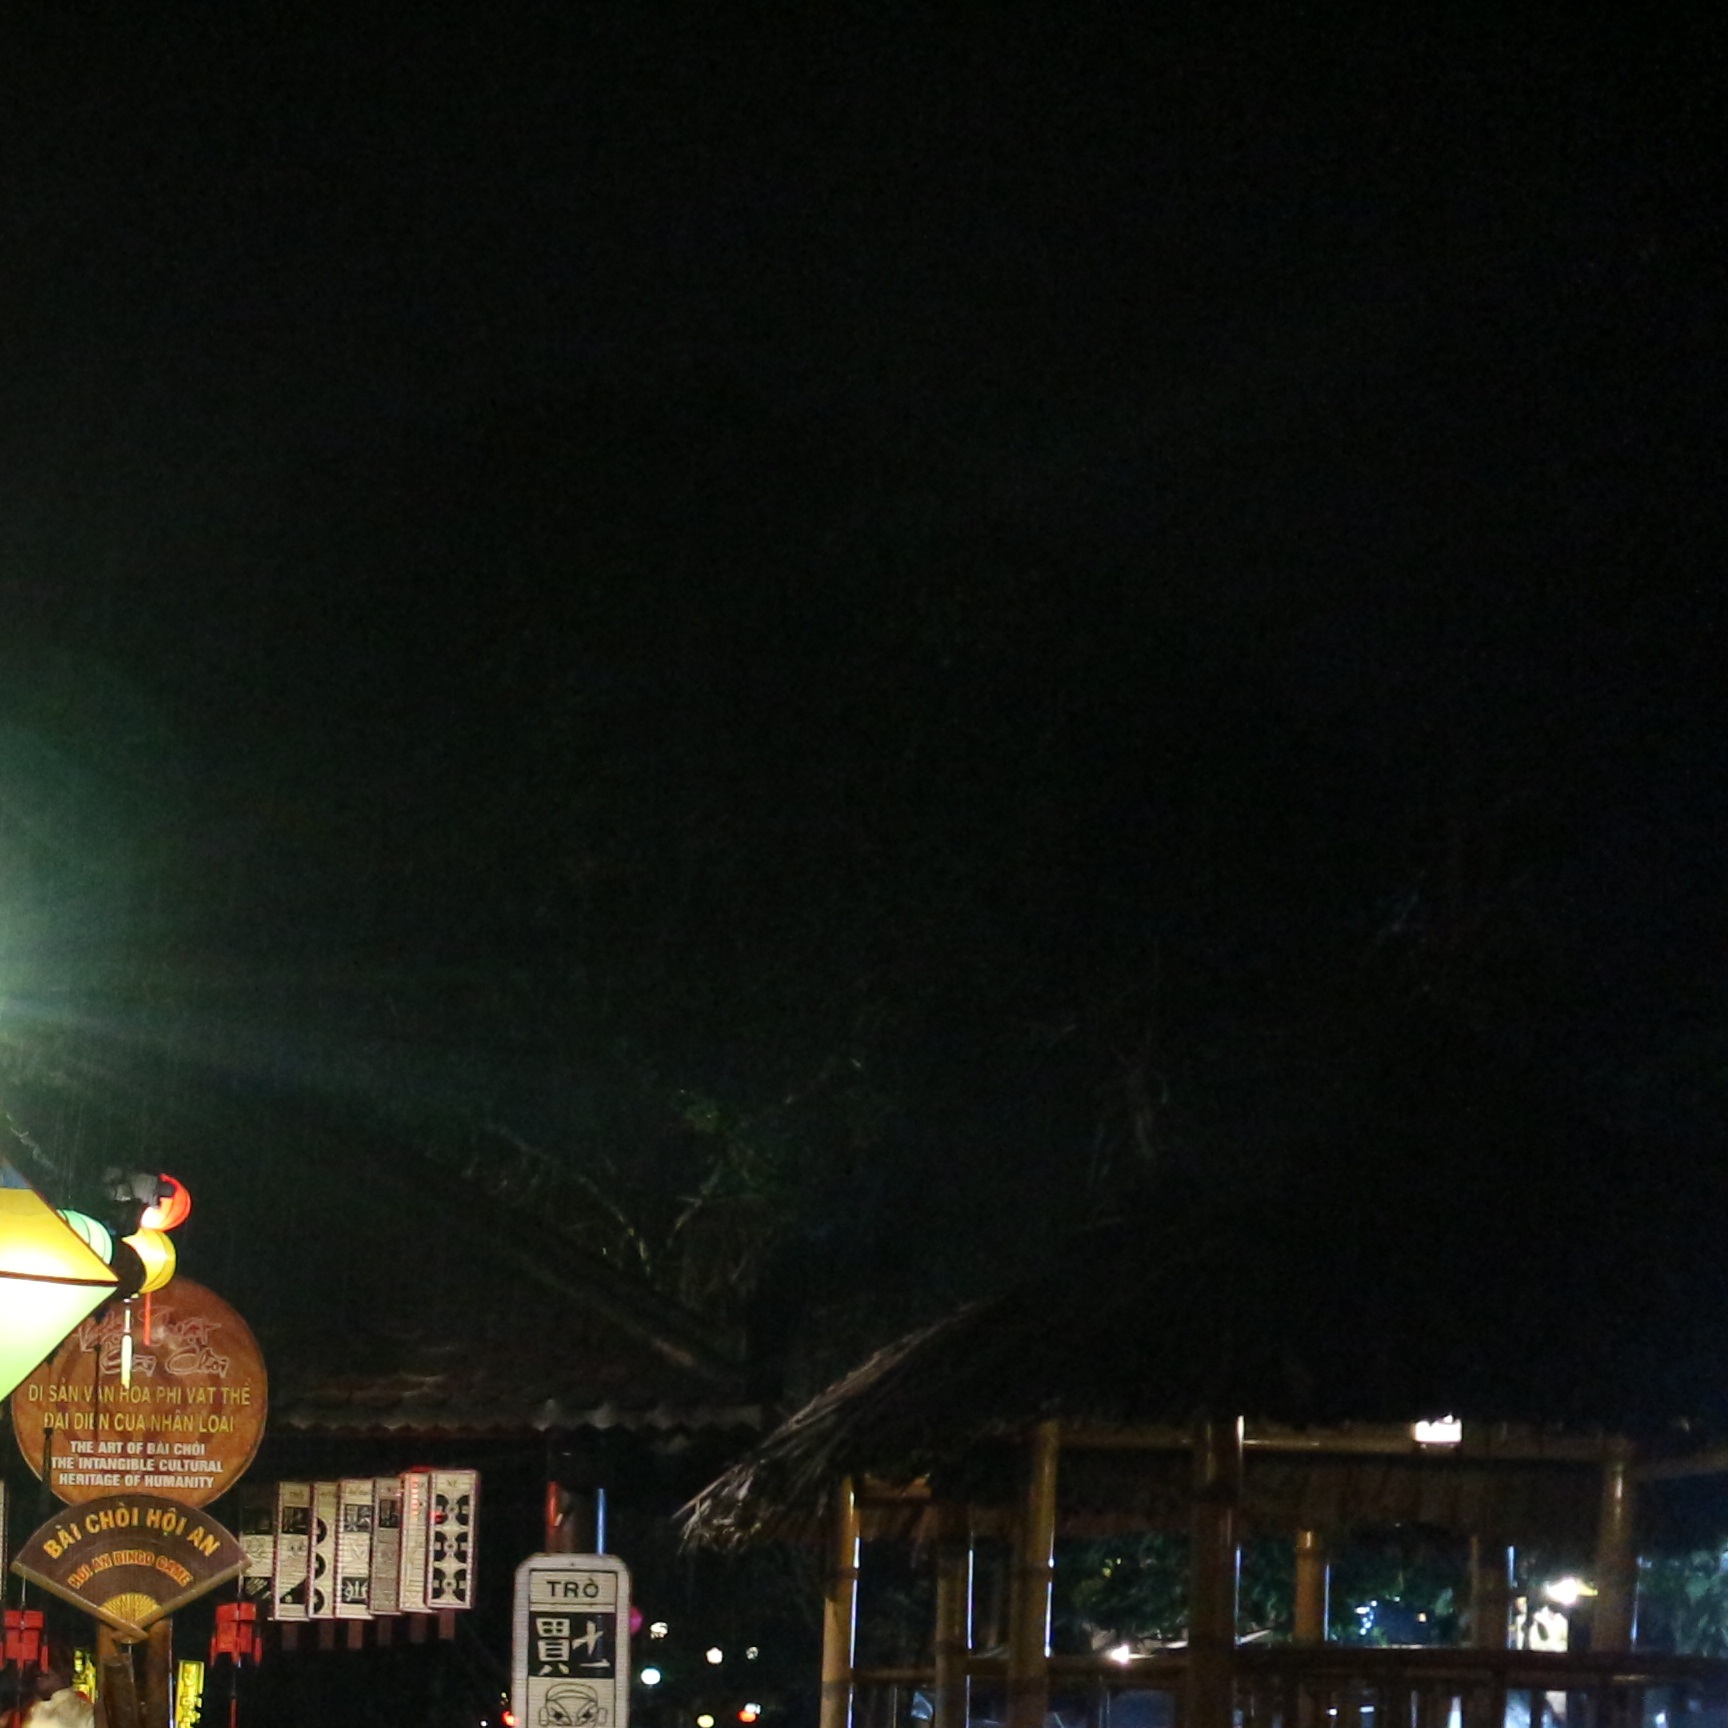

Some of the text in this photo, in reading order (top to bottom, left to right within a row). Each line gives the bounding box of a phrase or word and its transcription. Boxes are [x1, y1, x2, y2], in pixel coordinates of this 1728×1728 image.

[28, 1385, 43, 1401] DI
[70, 1440, 94, 1453] THE
[98, 1441, 124, 1454] ART
[126, 1441, 144, 1455] OF
[51, 1456, 223, 1473] THE INTANGIBLE CULTURAL
[59, 1472, 215, 1488] HERITAGE OF HUMANITY
[43, 1501, 221, 1559] BÀI CHÒI HỘI AN
[91, 1553, 113, 1573] AN
[112, 1549, 155, 1567] BINGO
[155, 1555, 194, 1588] GAME
[546, 1578, 599, 1598] TRÒ
